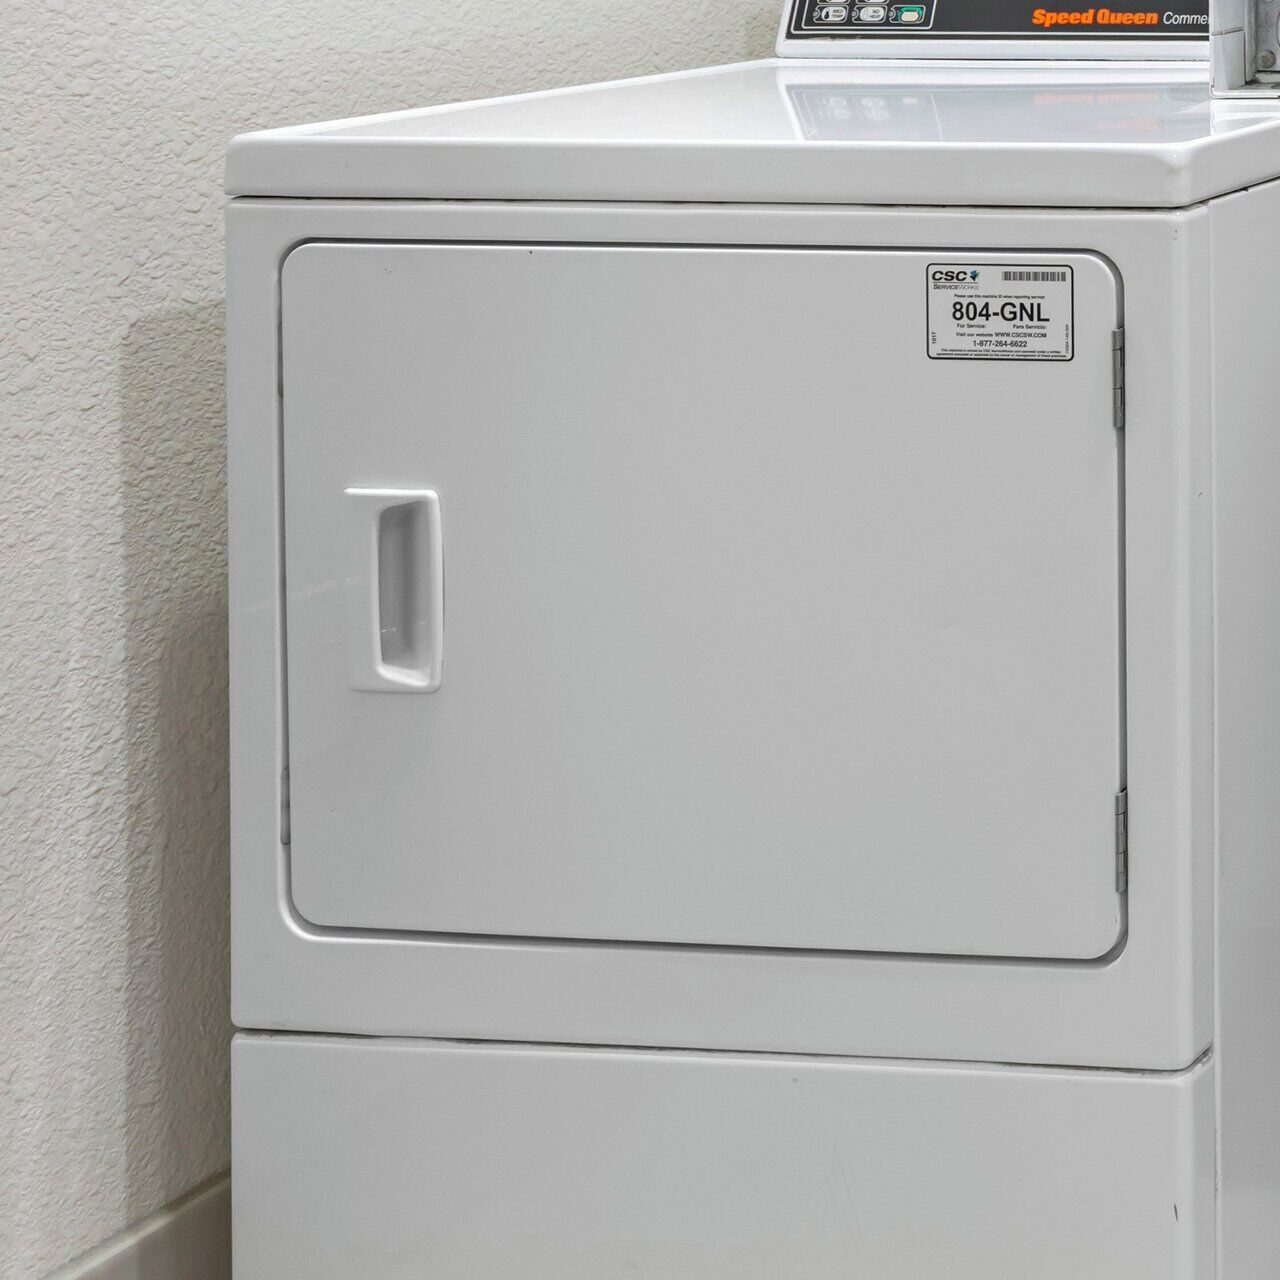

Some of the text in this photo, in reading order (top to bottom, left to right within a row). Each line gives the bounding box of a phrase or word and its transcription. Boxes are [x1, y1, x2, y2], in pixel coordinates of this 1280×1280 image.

[1031, 7, 1210, 27] Speed Queen Comme
[931, 270, 968, 282] CSC
[951, 301, 1051, 322] 804-GNL
